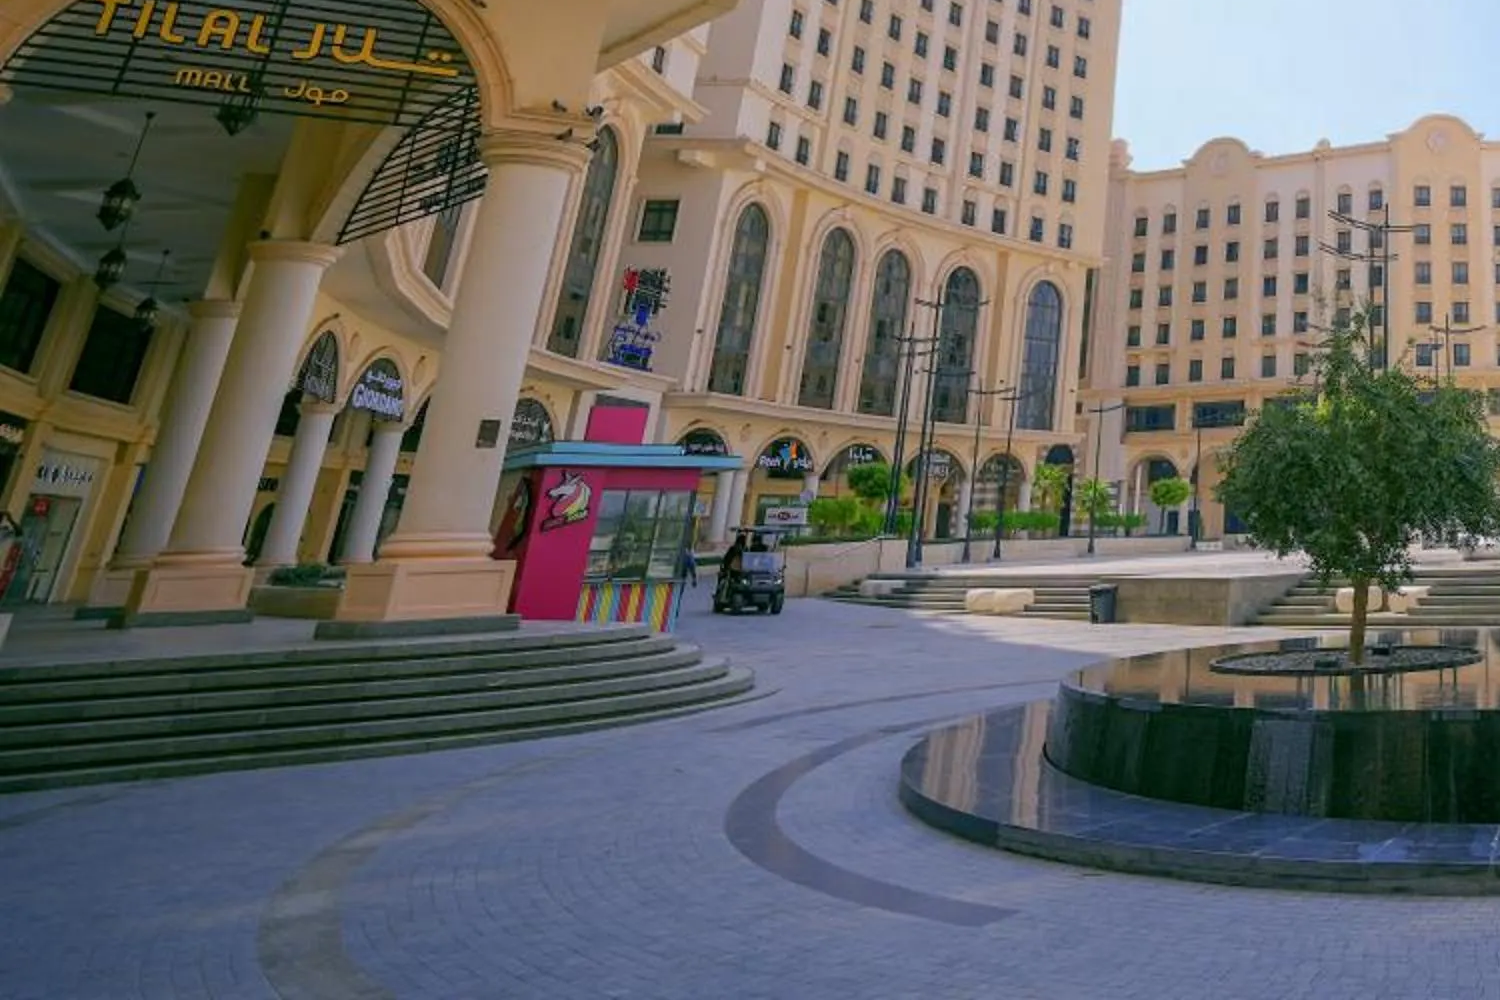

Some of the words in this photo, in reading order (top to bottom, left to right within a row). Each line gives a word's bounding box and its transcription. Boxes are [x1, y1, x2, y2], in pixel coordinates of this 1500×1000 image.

[292, 23, 459, 77] تلال
[175, 69, 251, 93] MALL
[284, 79, 349, 106] مول
